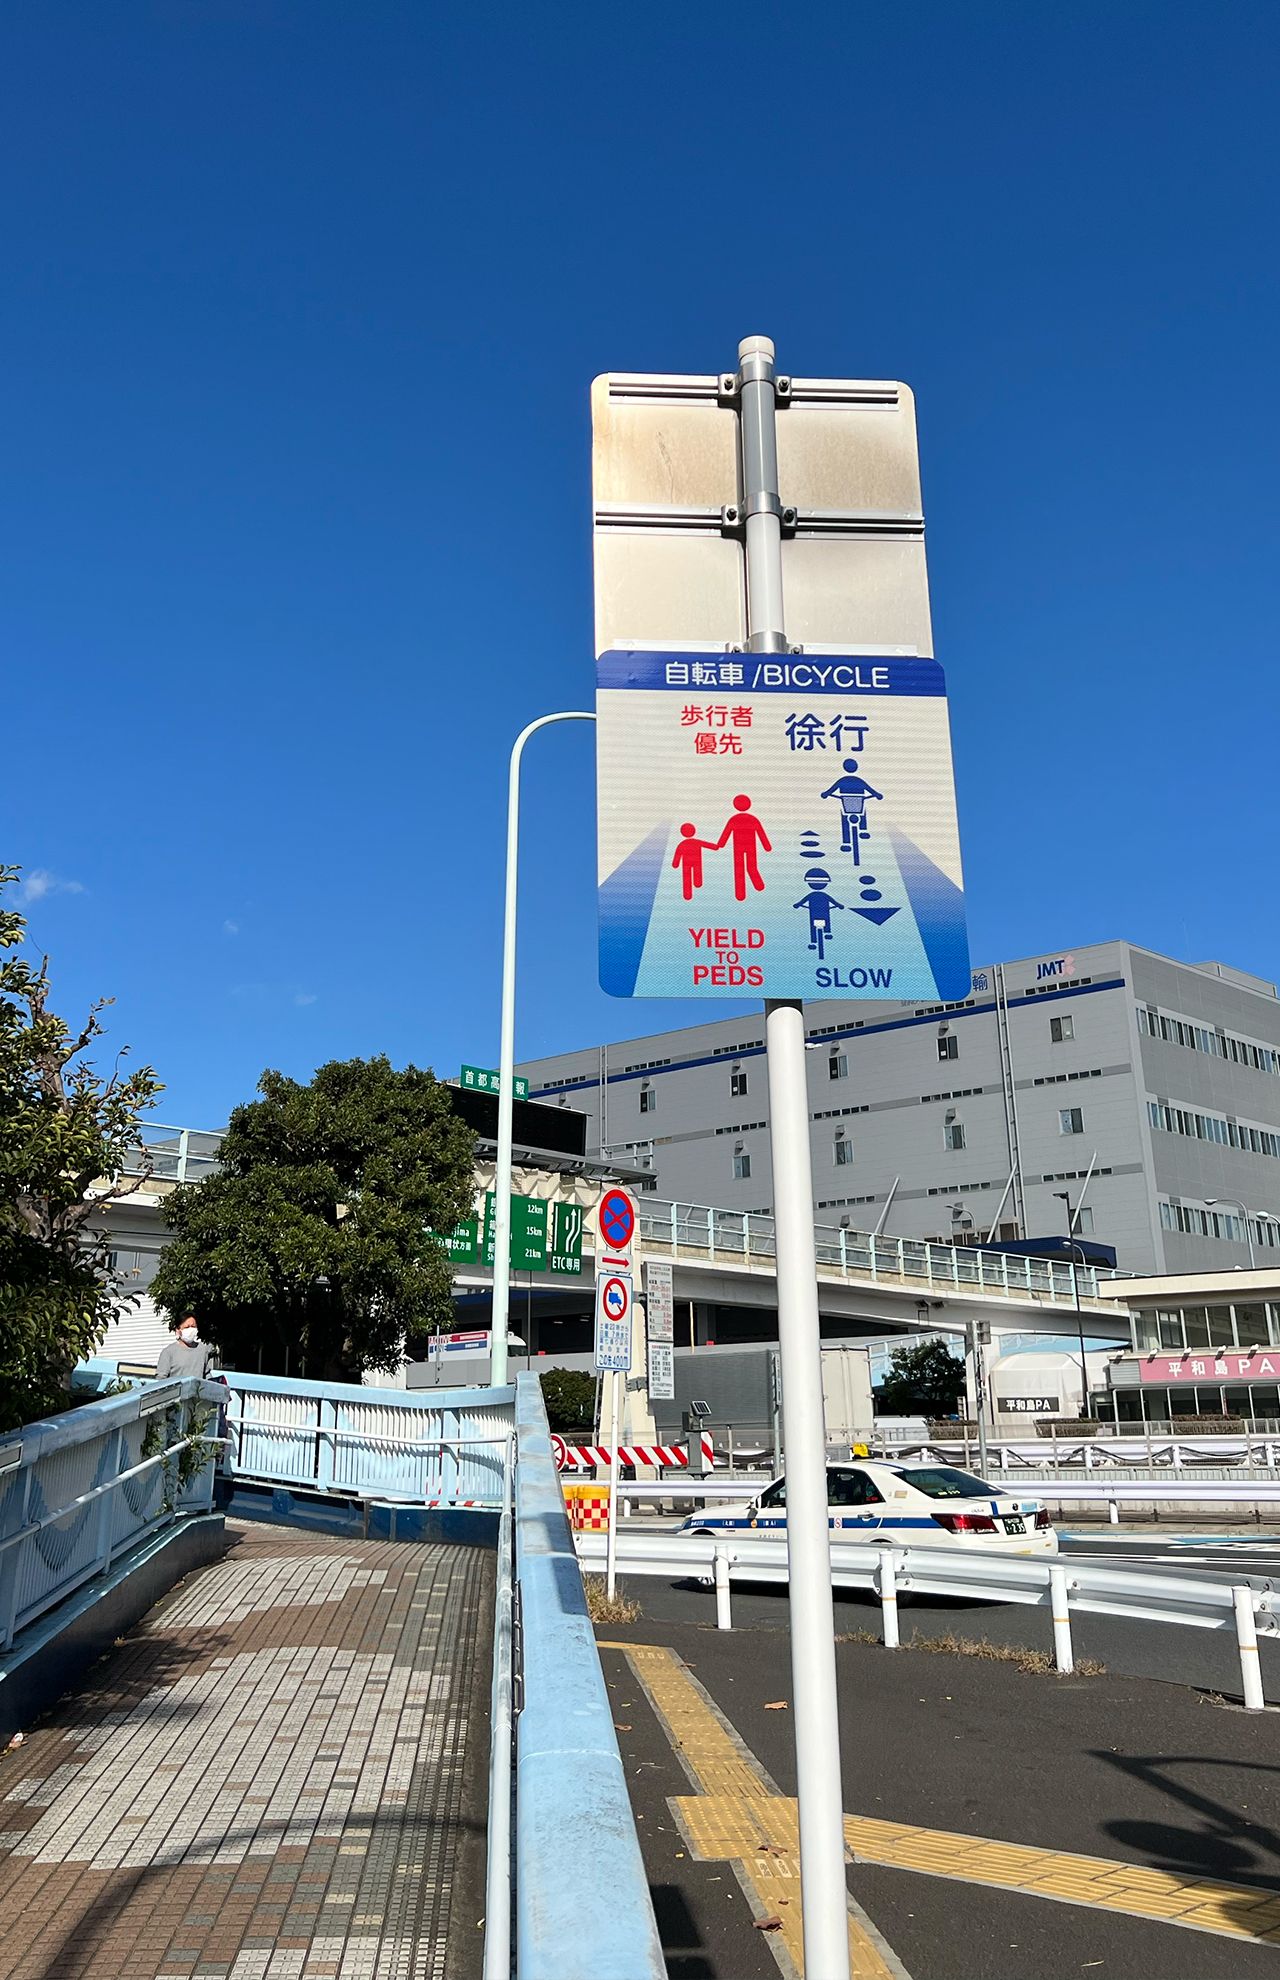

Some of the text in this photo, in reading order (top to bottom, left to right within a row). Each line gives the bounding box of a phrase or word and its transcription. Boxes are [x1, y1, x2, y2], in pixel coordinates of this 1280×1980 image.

[665, 662, 890, 688] 自転車 /BICYCLE
[680, 704, 753, 727] 歩行者
[785, 713, 870, 751] 徐行
[694, 732, 743, 754] 優先
[688, 928, 765, 949] YIELD
[715, 950, 739, 964] TO
[693, 965, 764, 986] PEDS
[815, 967, 892, 988] SLOW
[1036, 959, 1065, 980] JMT
[972, 973, 988, 991] 輸
[465, 1070, 525, 1095] 首都高報
[527, 1204, 543, 1214] 12km
[526, 1226, 542, 1236] 15km
[525, 1248, 541, 1258] 21km
[552, 1256, 580, 1271] ETC専用
[1168, 1358, 1275, 1377] 平和島PA
[1006, 1399, 1051, 1411] 平和島PA
